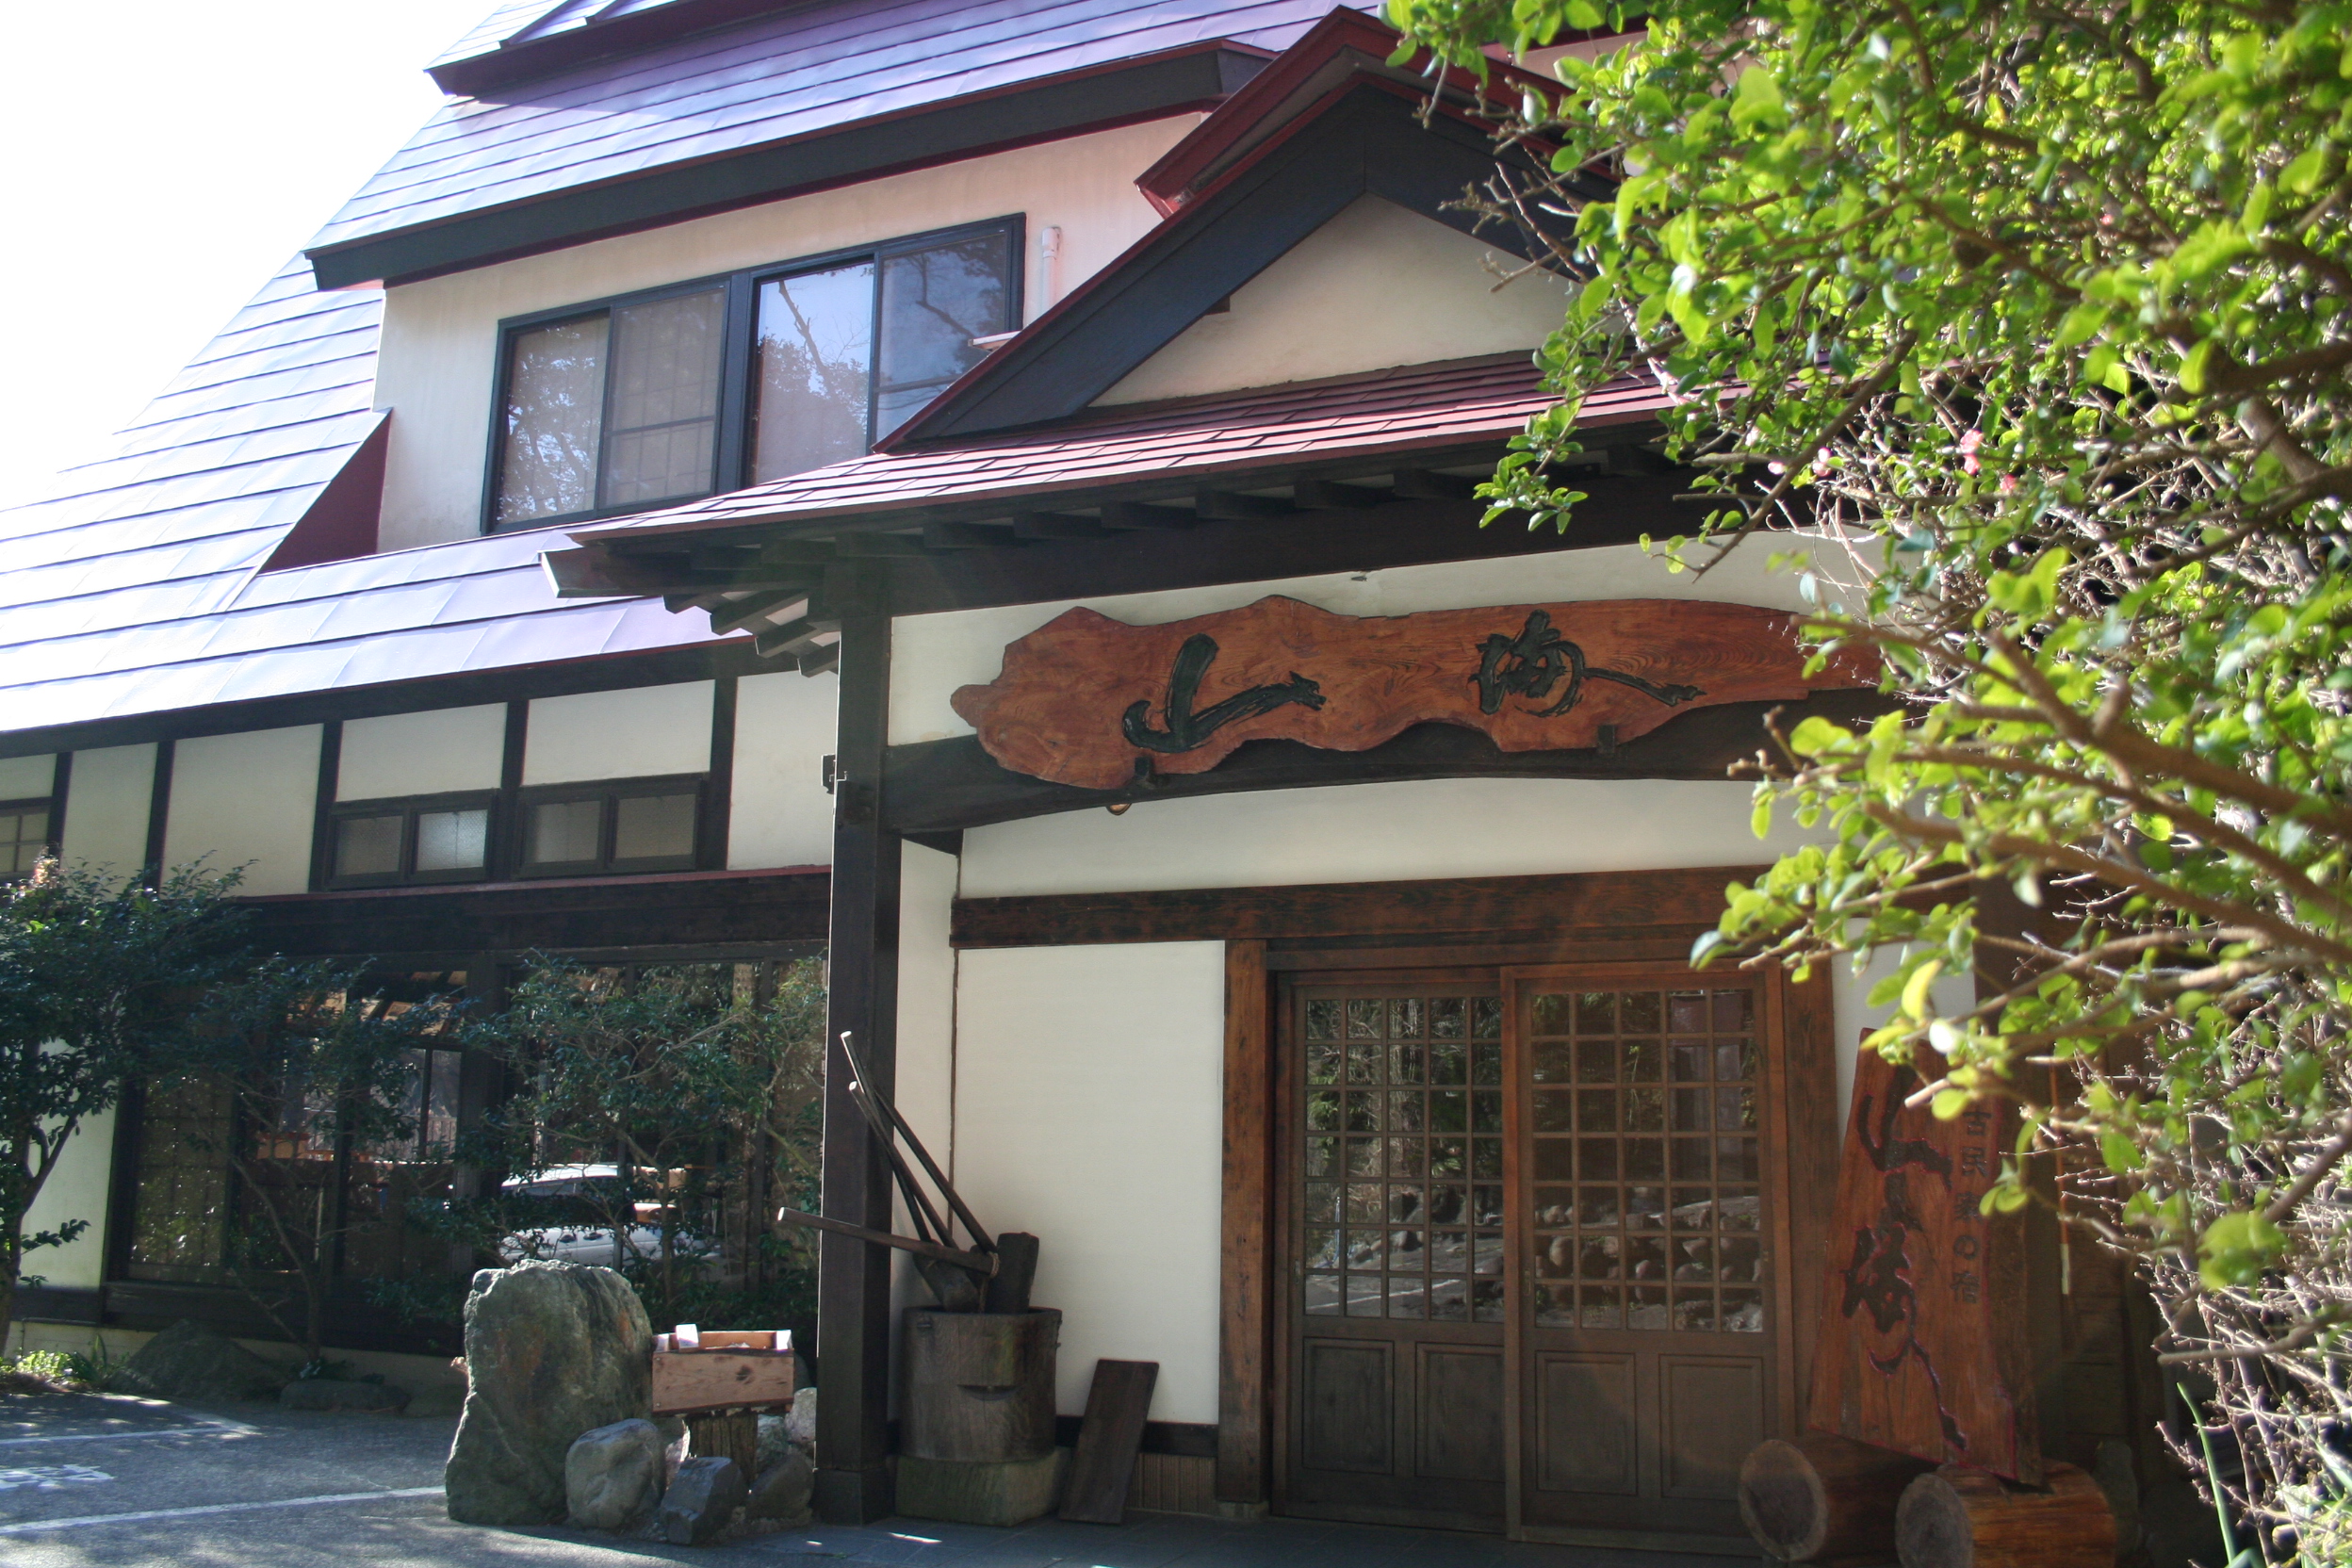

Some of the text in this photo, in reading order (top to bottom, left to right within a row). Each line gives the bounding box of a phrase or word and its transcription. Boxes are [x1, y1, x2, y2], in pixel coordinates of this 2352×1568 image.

[1950, 1103, 1992, 1304] 古民家の宿
